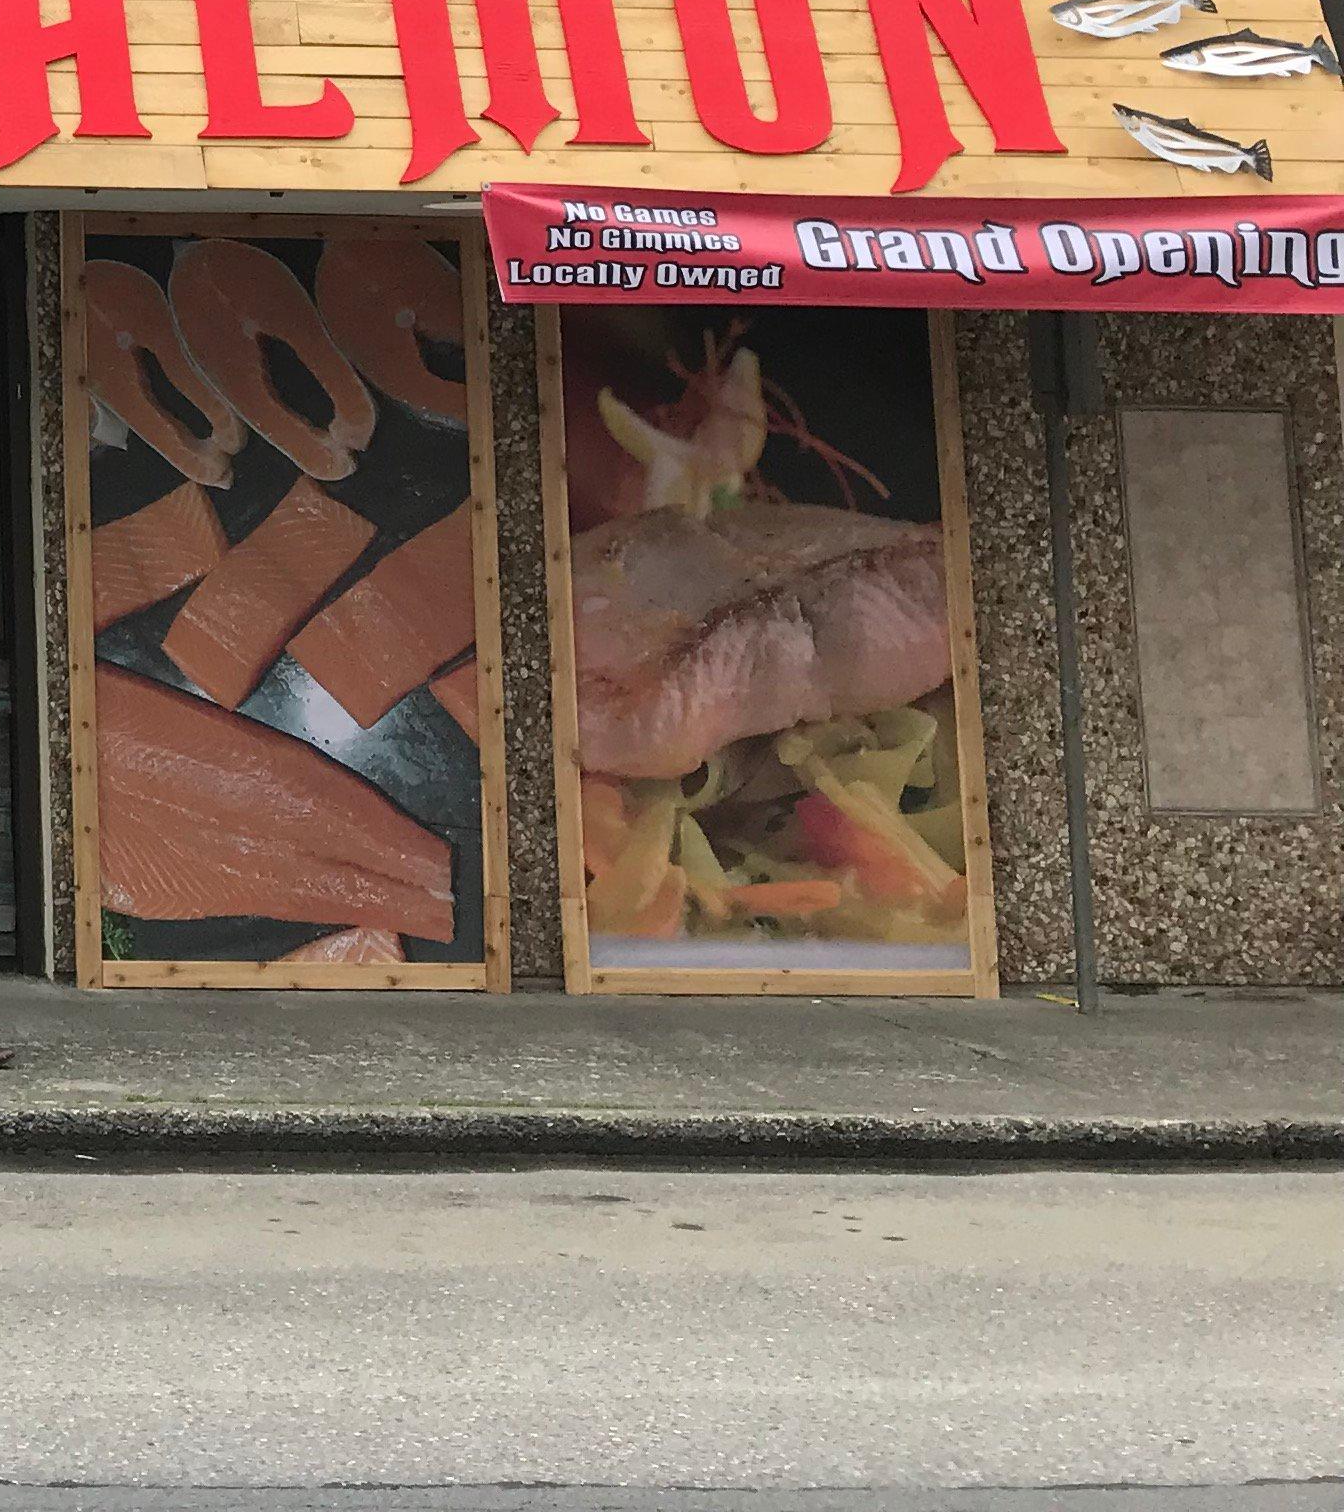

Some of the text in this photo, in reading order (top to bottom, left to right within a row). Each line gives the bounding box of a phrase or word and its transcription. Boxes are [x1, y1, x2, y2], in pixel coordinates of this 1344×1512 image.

[563, 201, 717, 227] No Games
[547, 225, 741, 253] No Gimmics
[794, 217, 1344, 289] Grand Opening
[508, 258, 784, 292] Locally Owned
